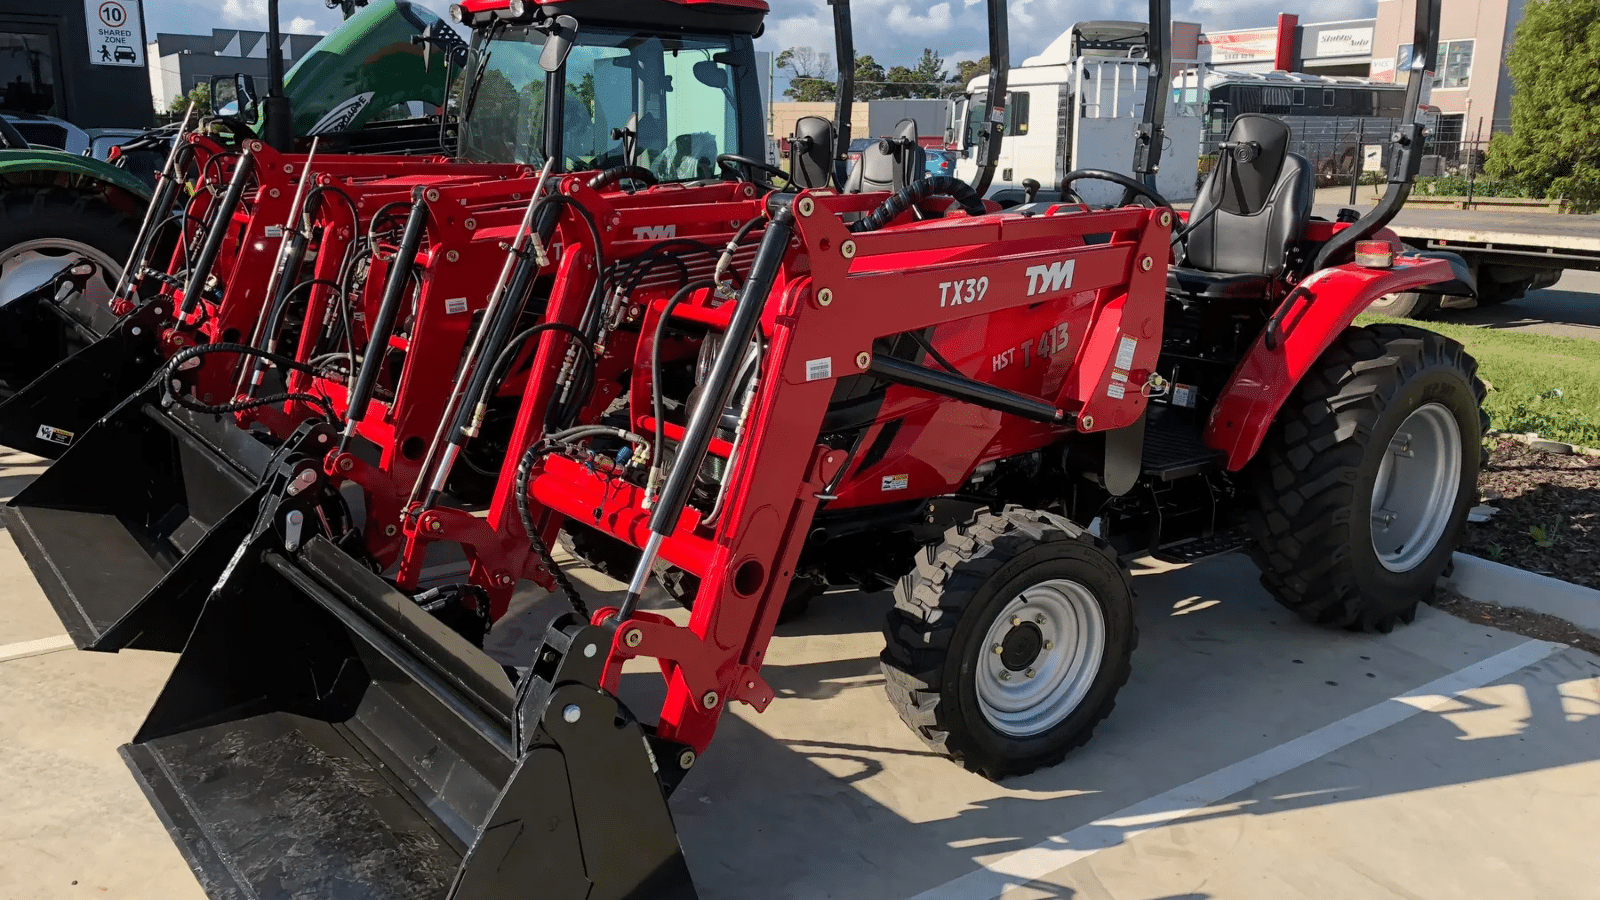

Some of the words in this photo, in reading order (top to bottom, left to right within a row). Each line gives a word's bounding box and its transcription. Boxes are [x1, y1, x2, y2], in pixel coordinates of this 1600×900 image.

[102, 7, 121, 21] 10
[98, 28, 131, 36] SHARED
[632, 224, 676, 240] TYM
[938, 276, 989, 308] TX39
[1025, 259, 1076, 296] TYM
[992, 347, 1016, 372] HST
[1037, 322, 1069, 358] 413
